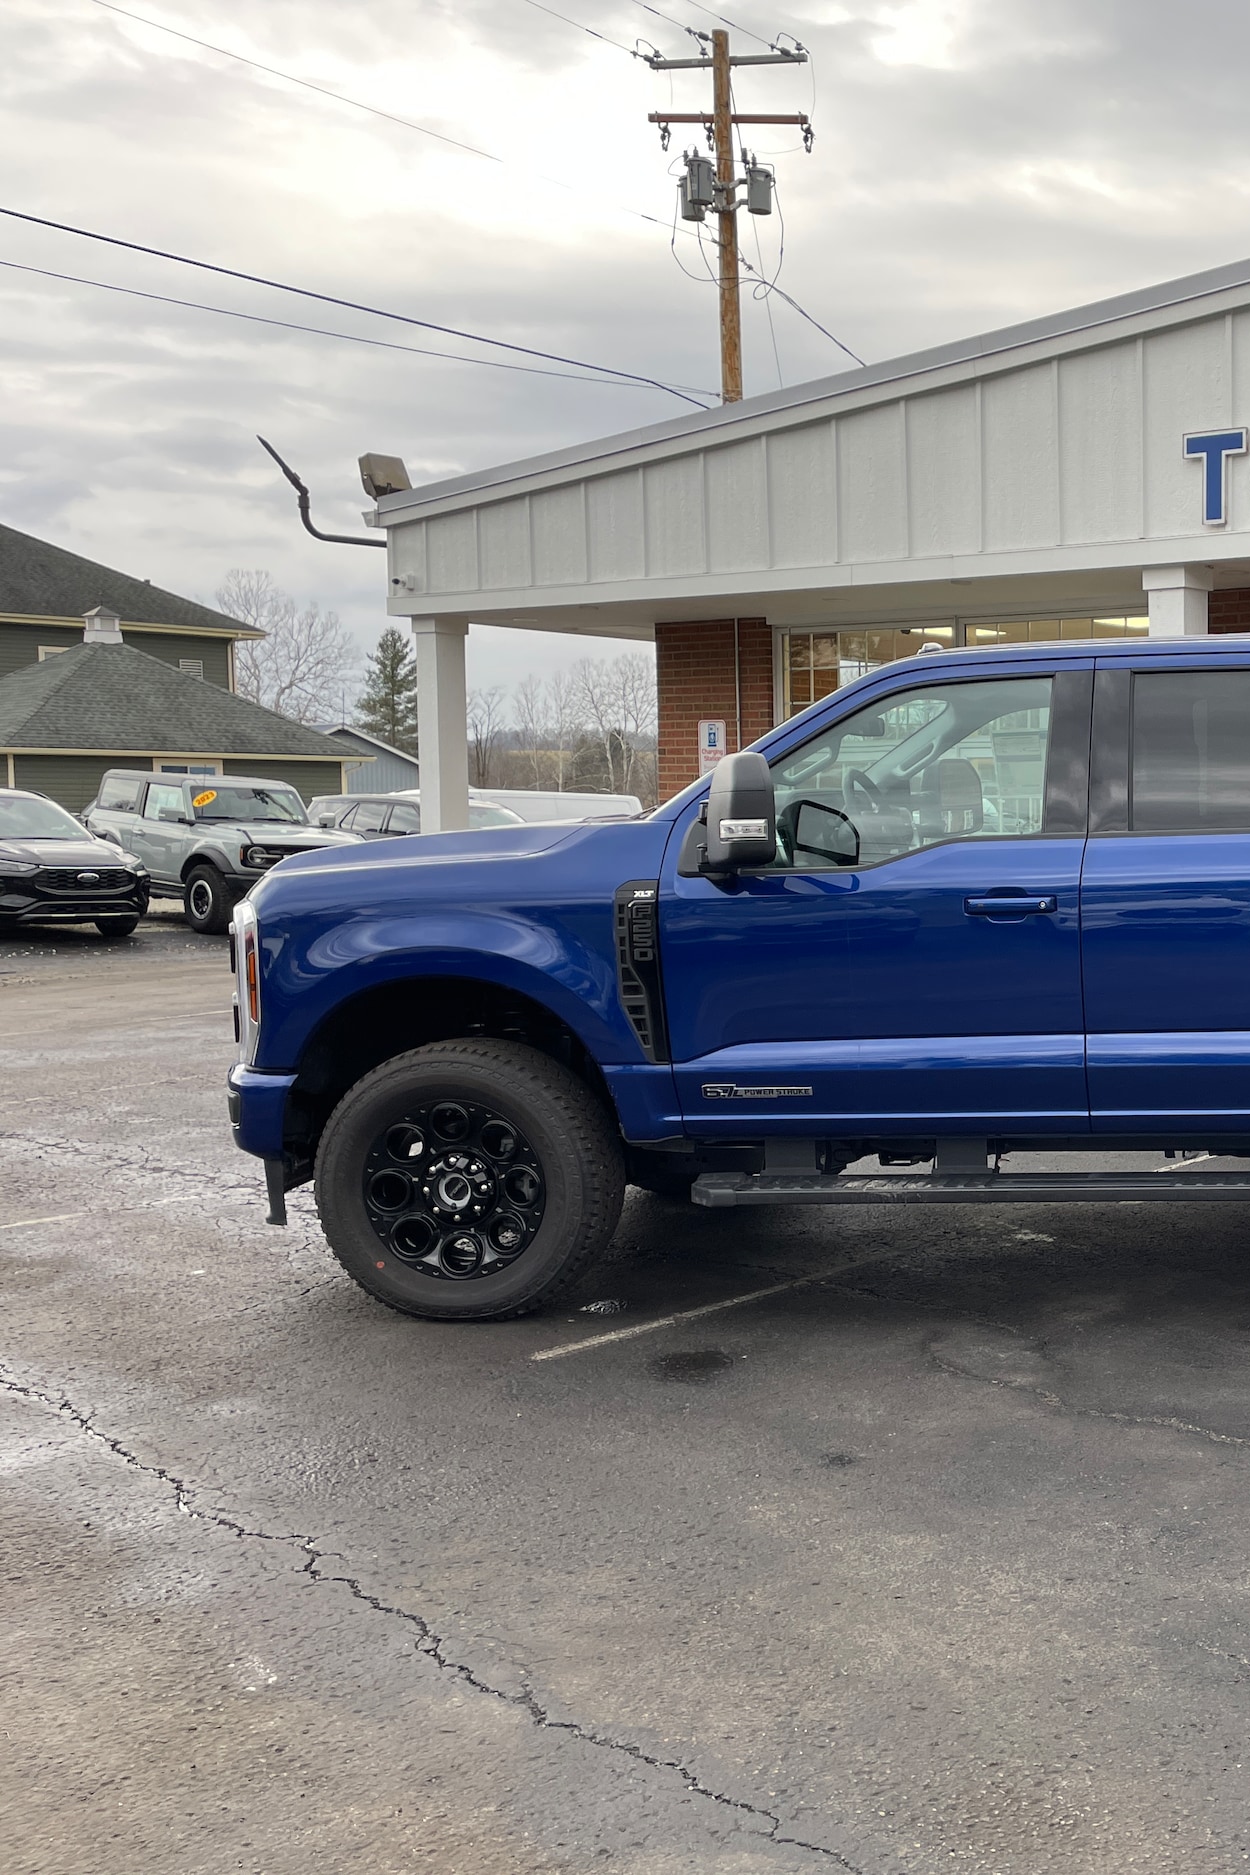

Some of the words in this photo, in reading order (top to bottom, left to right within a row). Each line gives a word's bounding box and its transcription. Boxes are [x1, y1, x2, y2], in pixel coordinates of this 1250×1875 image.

[701, 748, 724, 756] Charging
[195, 791, 215, 806] 2023
[633, 890, 655, 898] XLT
[744, 1088, 774, 1096] POWER
[776, 1088, 811, 1096] STROKE
